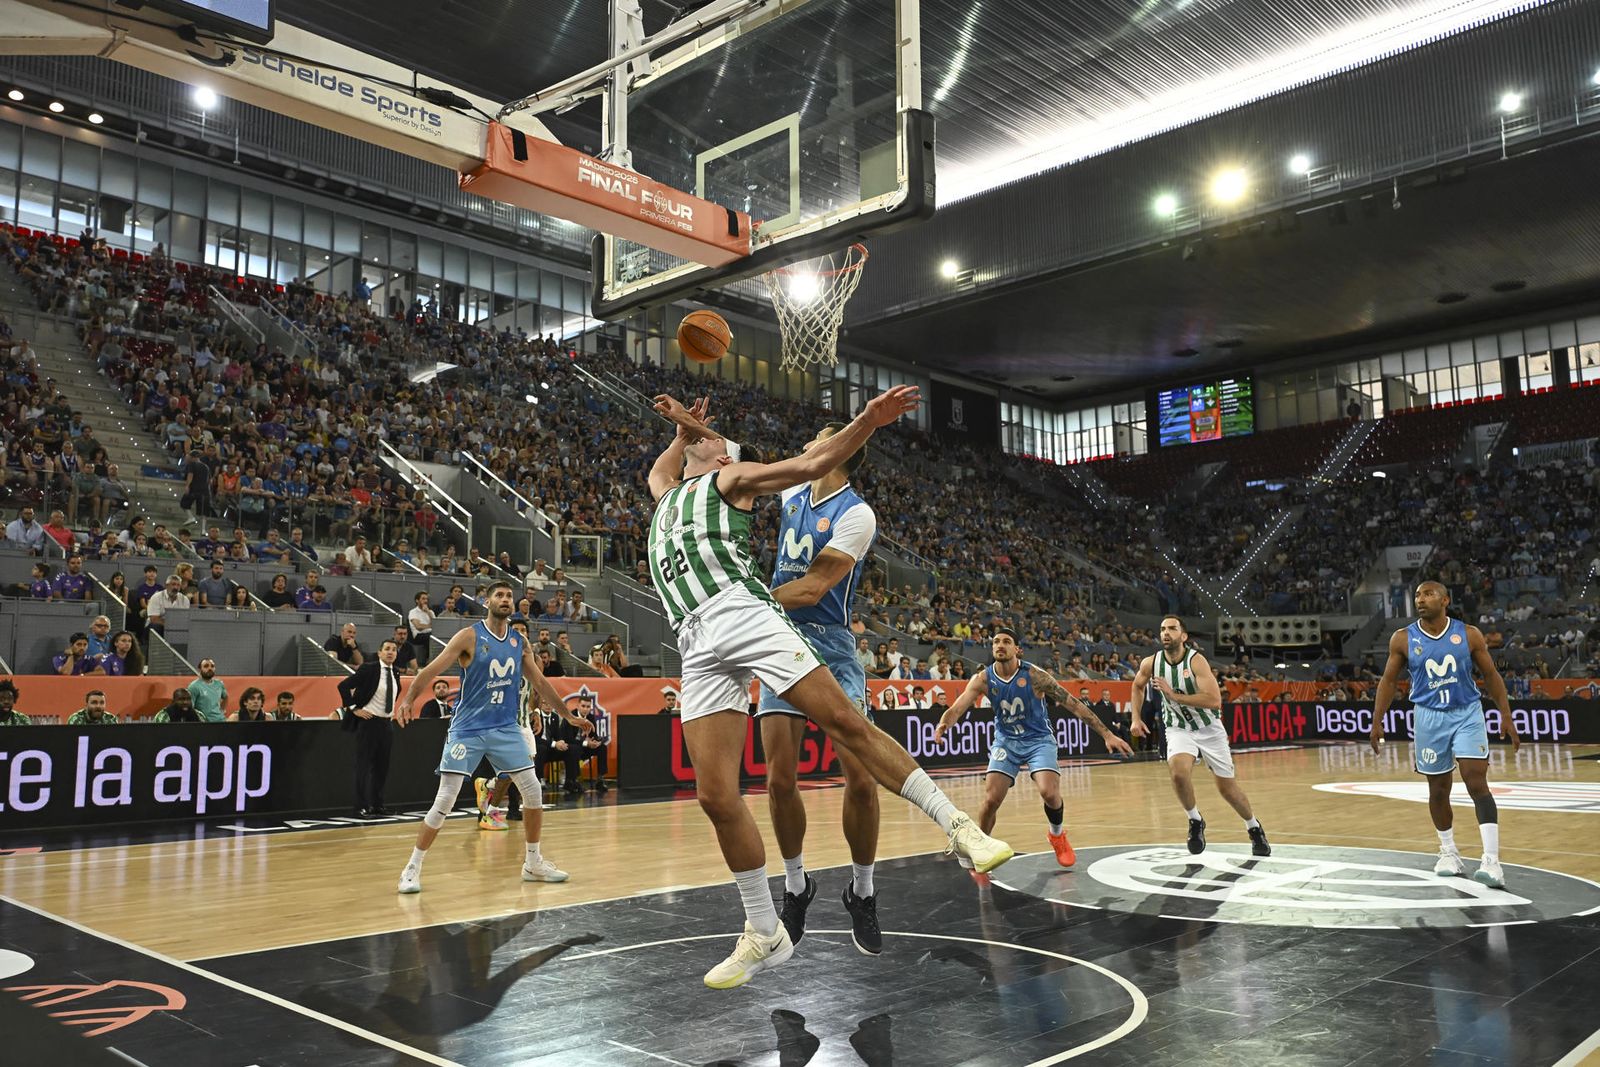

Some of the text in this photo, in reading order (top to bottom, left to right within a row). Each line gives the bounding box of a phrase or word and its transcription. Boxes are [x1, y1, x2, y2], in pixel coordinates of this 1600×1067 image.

[241, 46, 442, 127] Schelde Sports
[383, 111, 410, 126] Superior
[420, 123, 442, 137] Design
[577, 166, 693, 221] FINAL FOUR
[639, 208, 693, 231] PRIMERA FEB
[660, 548, 690, 584] 22
[1439, 689, 1450, 704] 11
[906, 711, 1091, 758] Descárg app
[1223, 702, 1307, 743] ALIGA+
[1511, 708, 1571, 741] app
[74, 735, 132, 808] la
[153, 744, 272, 814] app
